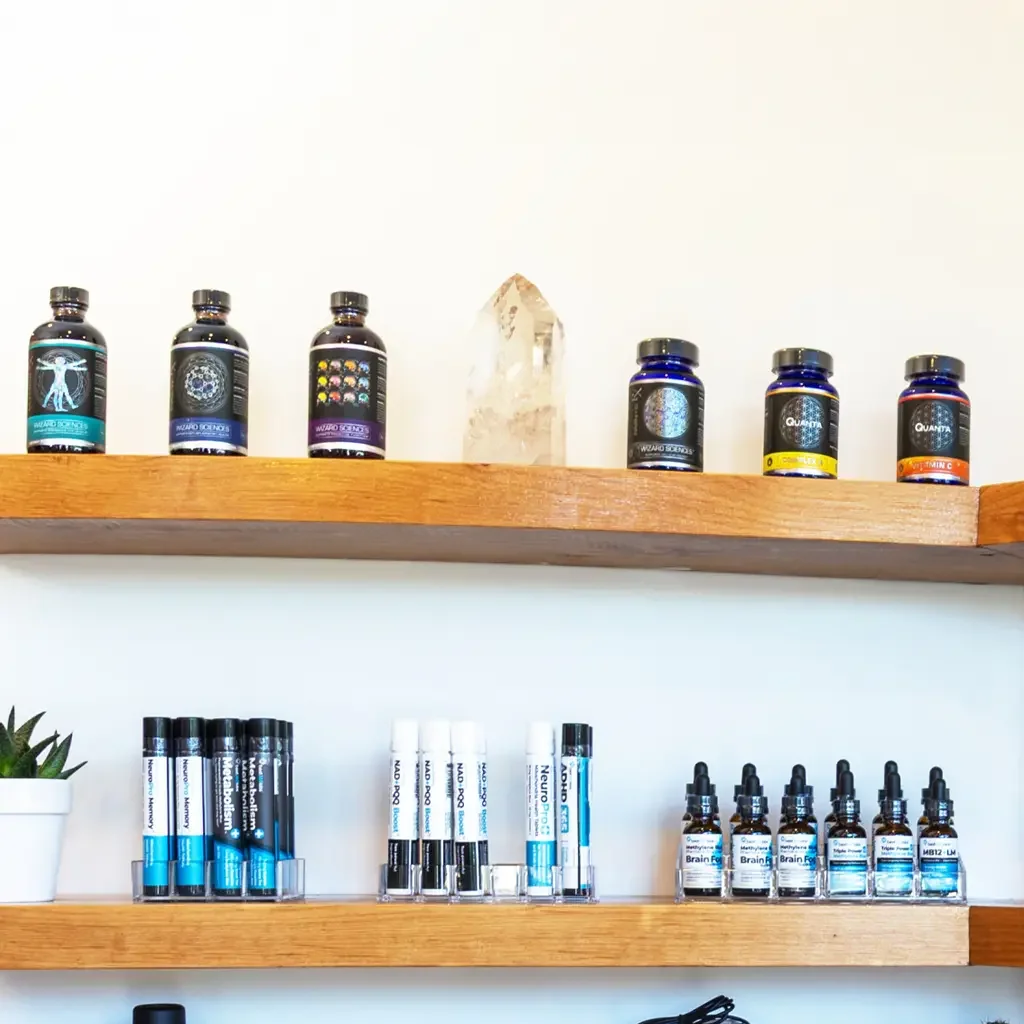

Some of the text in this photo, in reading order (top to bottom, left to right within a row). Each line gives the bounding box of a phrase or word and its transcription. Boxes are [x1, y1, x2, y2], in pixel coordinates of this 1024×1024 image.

[222, 757, 235, 831] Metabolism
[249, 757, 258, 831] Metabolism
[540, 765, 549, 824] NeuroPro
[147, 797, 155, 830] Memory
[182, 797, 190, 830] Memory
[457, 810, 465, 836] Boost
[686, 855, 709, 863] Brain
[740, 856, 764, 864] Brain
[780, 855, 802, 863] Brain
